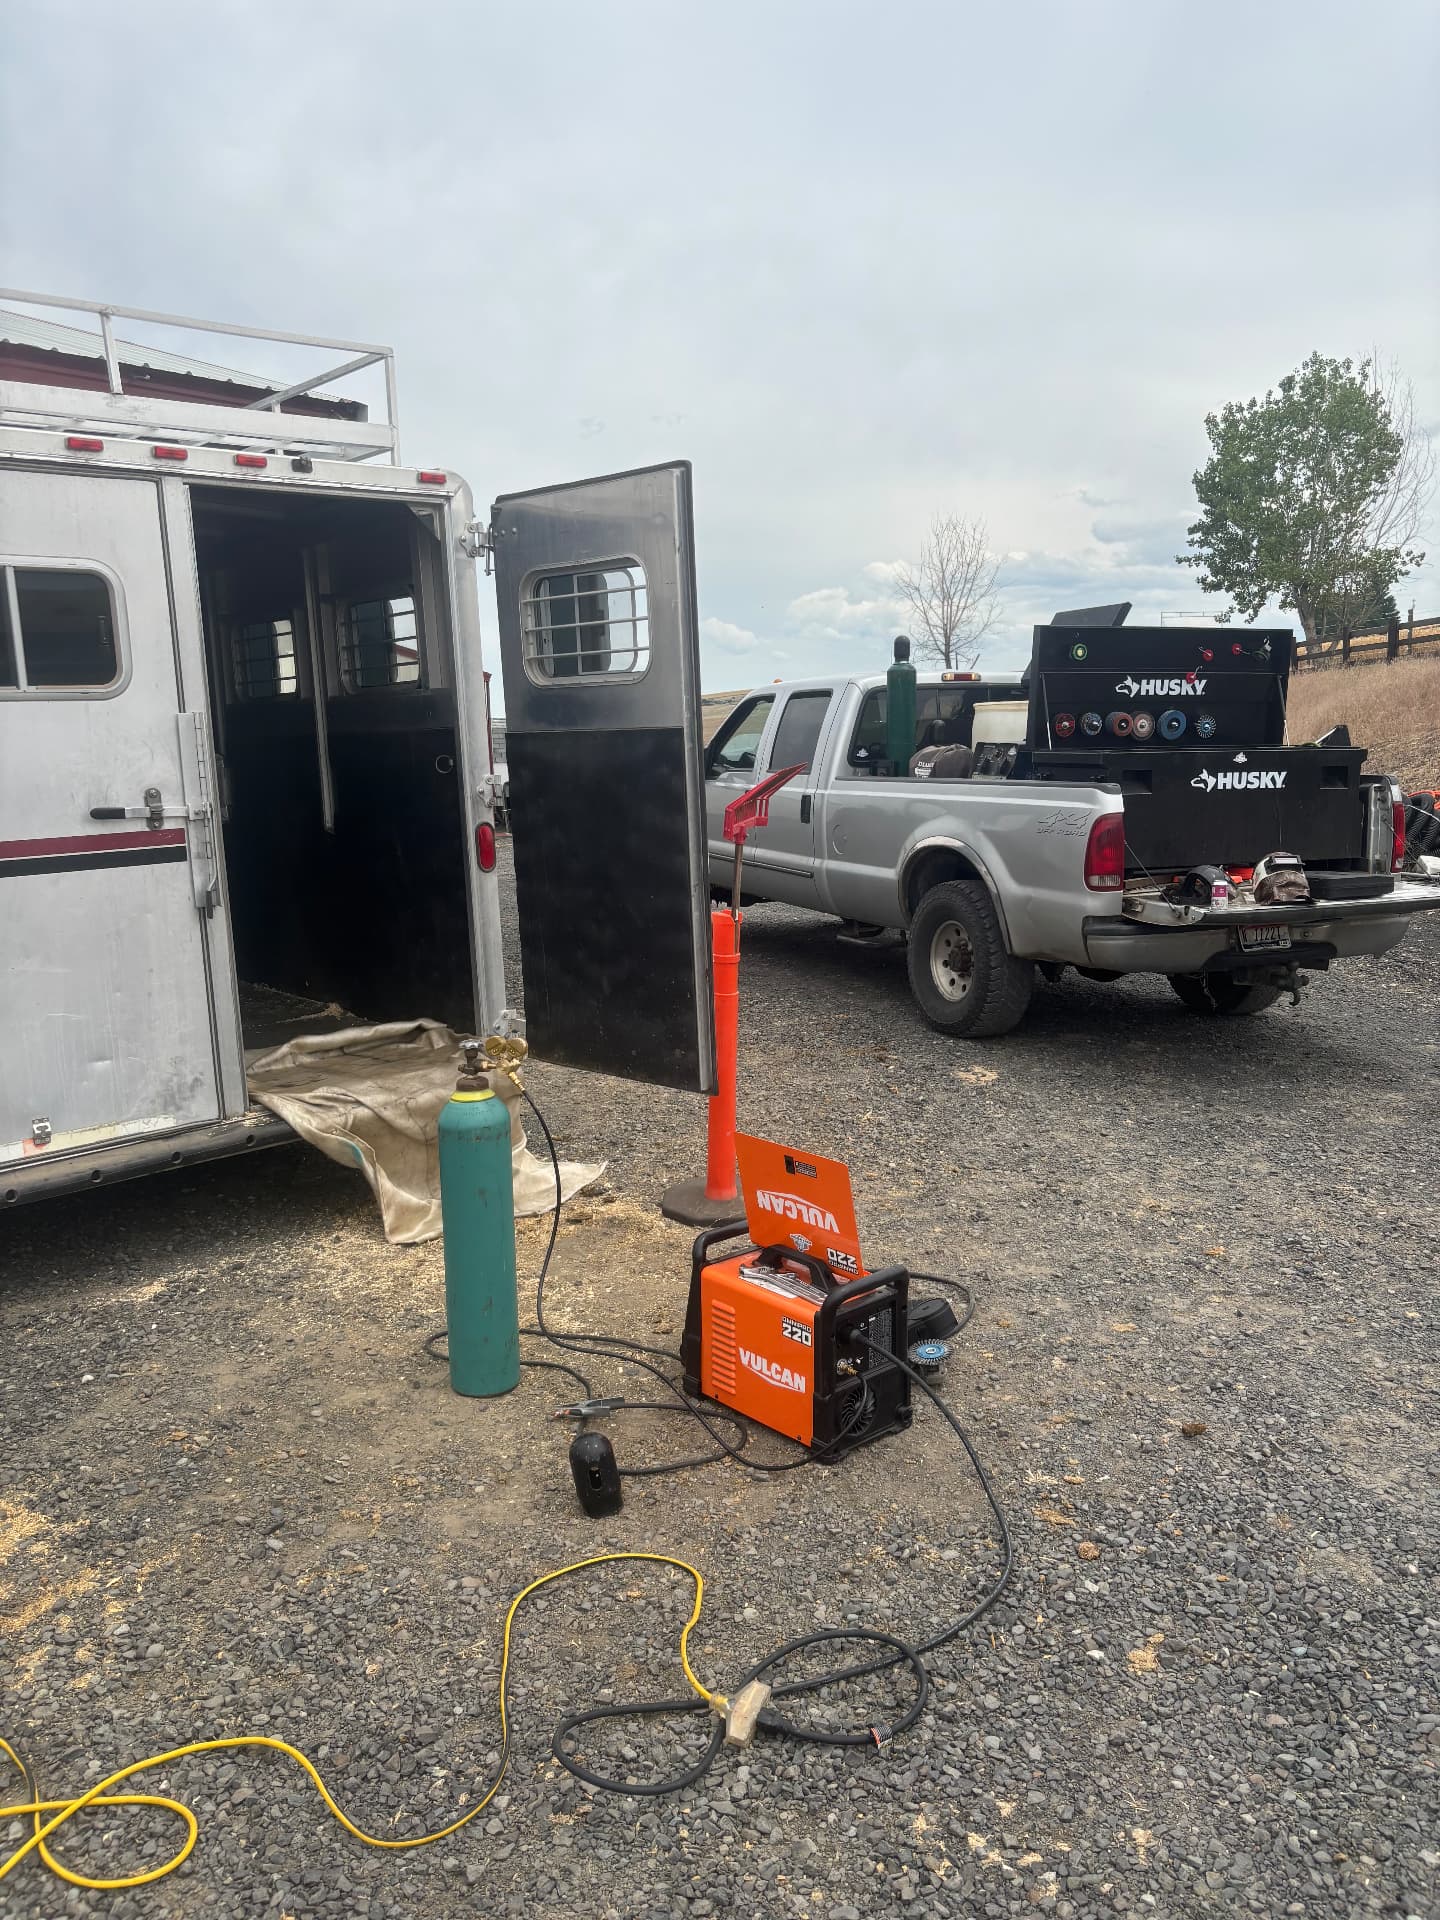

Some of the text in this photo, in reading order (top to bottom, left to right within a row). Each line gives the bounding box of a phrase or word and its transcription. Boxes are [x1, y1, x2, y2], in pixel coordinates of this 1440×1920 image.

[1140, 679, 1207, 696] HUSKY
[1217, 771, 1287, 790] HUSKY
[756, 1190, 841, 1234] VULCAN
[827, 1247, 858, 1269] 220
[782, 1322, 812, 1347] 220
[739, 1346, 806, 1393] VULCAN
